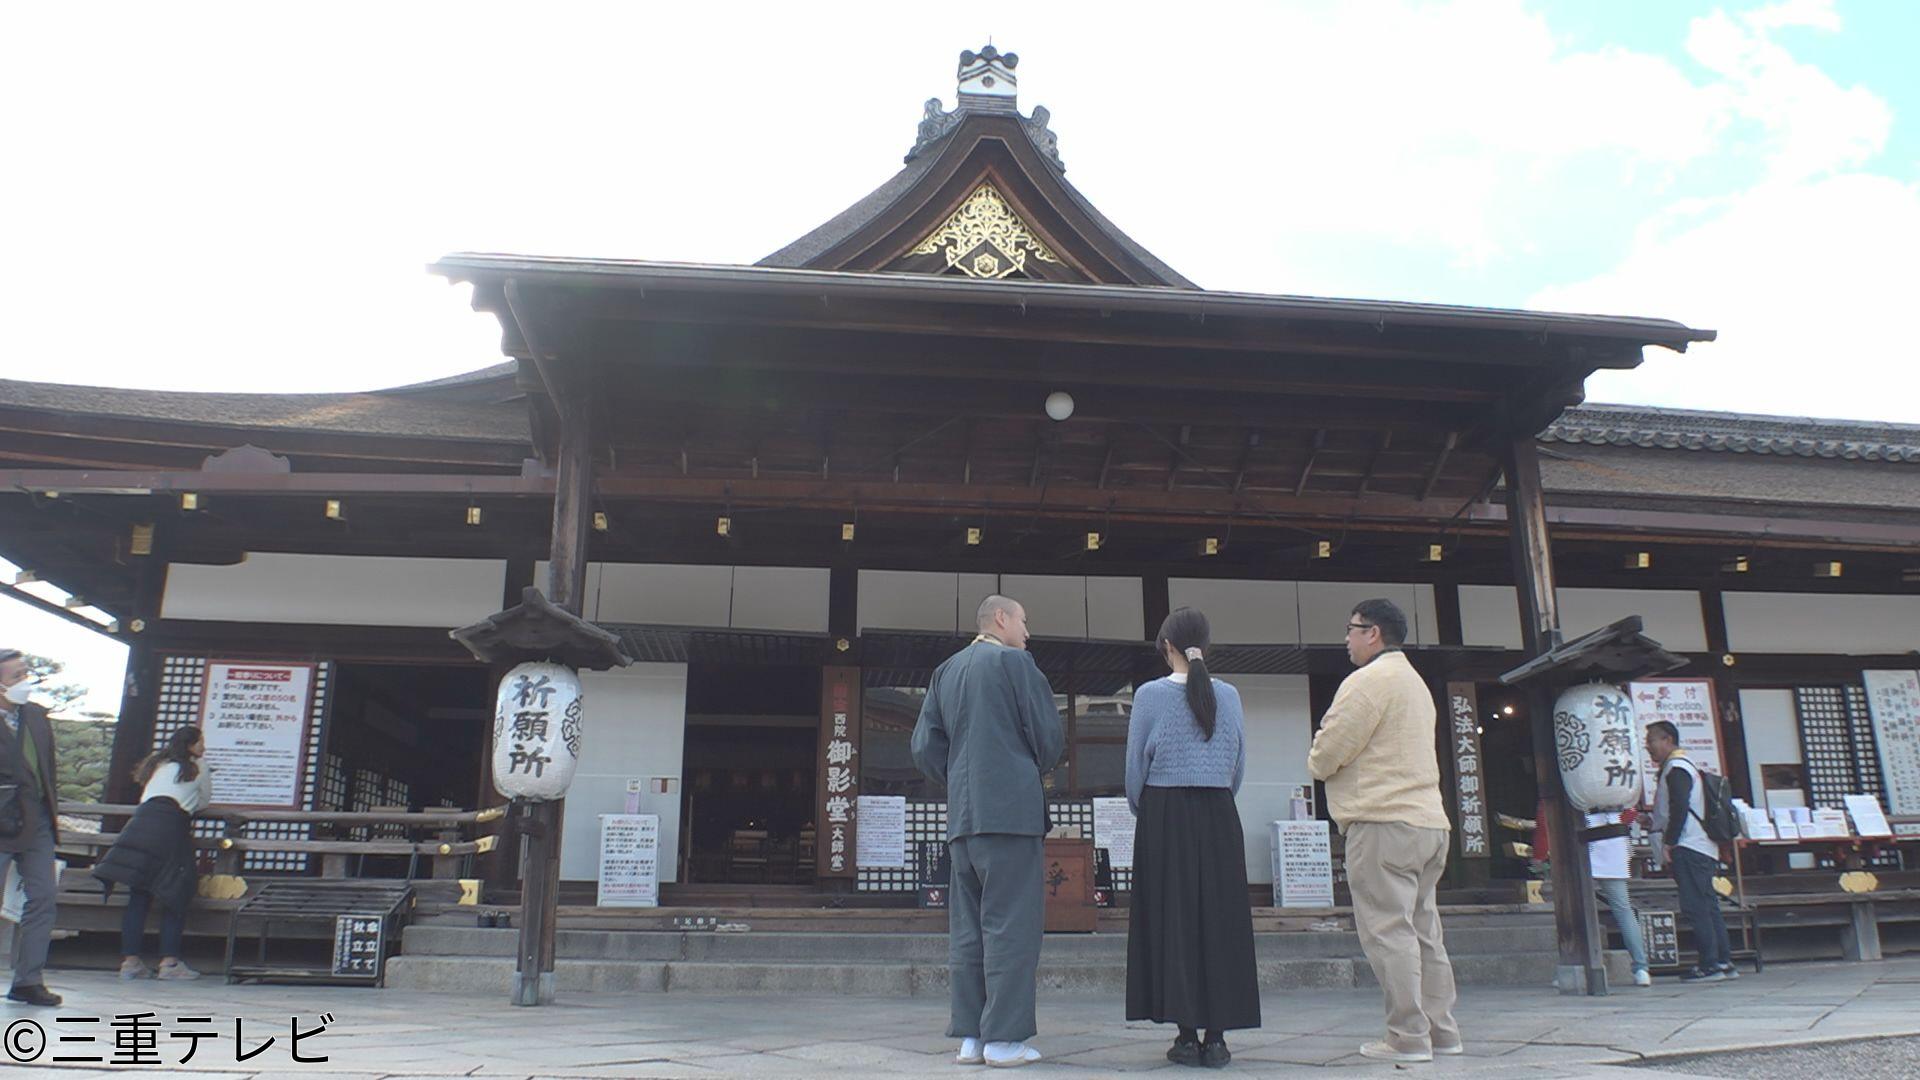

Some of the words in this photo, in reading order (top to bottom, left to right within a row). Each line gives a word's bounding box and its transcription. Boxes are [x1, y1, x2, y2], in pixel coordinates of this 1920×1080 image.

[509, 674, 557, 778] 祈願所
[1595, 694, 1637, 789] 祈願所
[1655, 700, 1703, 711] Reception
[1452, 696, 1486, 853] 弘法大師御祈願所
